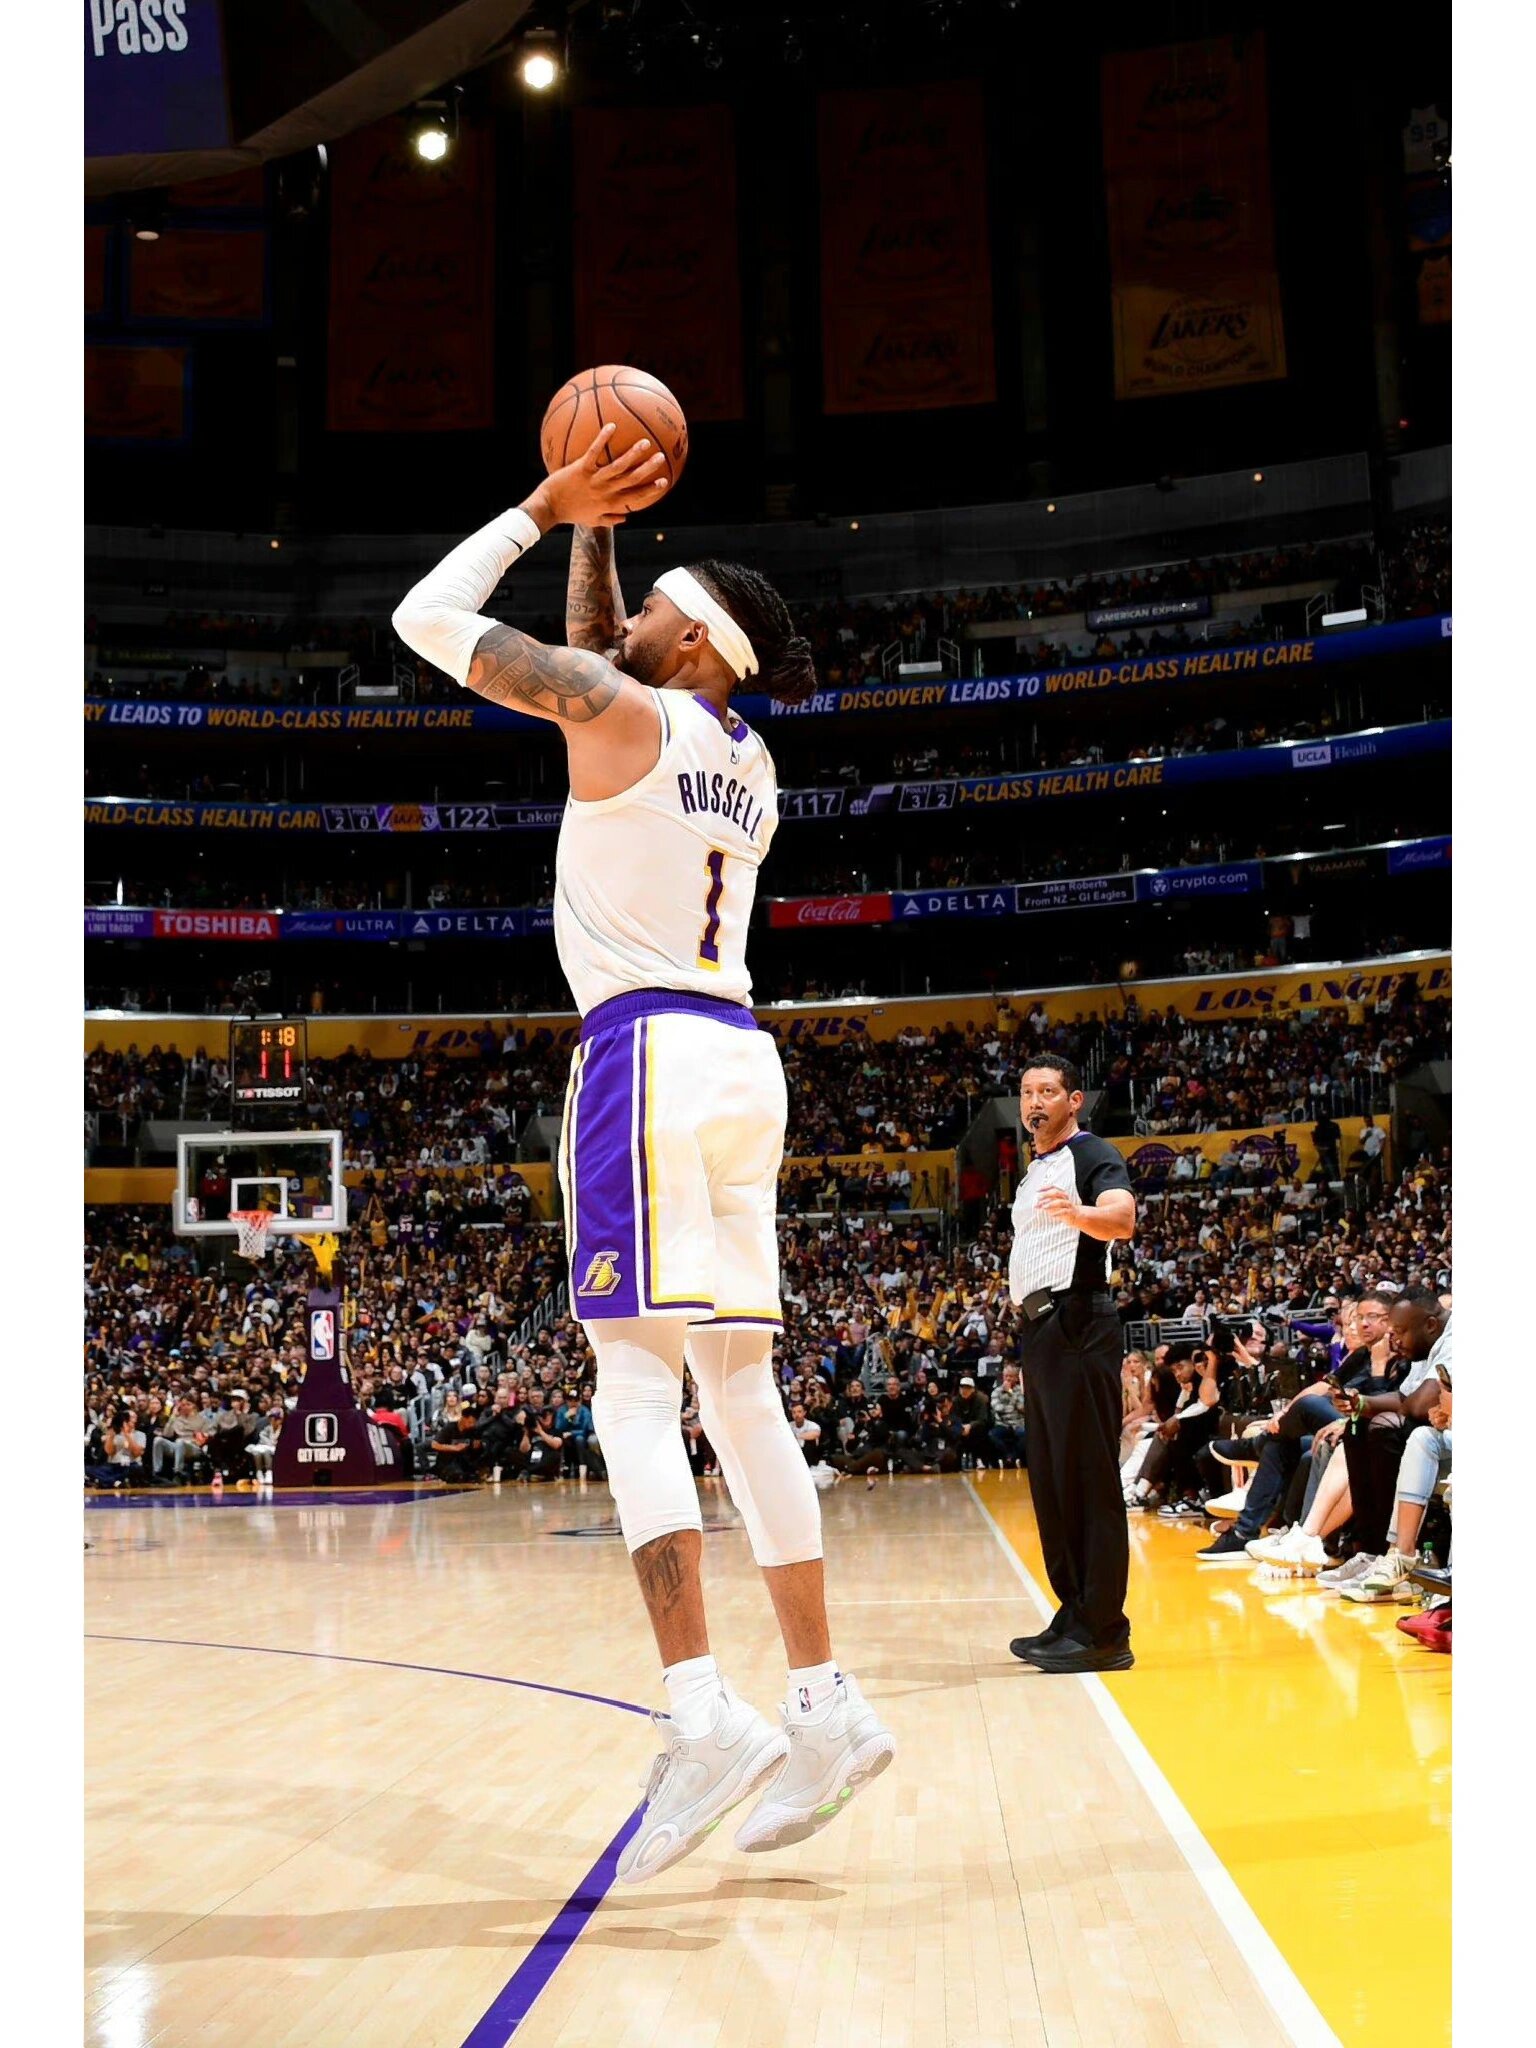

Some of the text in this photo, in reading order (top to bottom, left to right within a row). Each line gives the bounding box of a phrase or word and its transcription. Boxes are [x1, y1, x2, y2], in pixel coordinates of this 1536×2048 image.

[89, 0, 188, 56] Pass
[1096, 608, 1149, 623] AMERICAN
[839, 686, 947, 711] DISCOVERY
[950, 680, 1011, 703] LEADS
[1017, 677, 1040, 697] TO
[1044, 660, 1178, 692] WORLD-CLASS
[1183, 649, 1258, 676] HEALTH
[1262, 642, 1315, 666] CARE
[109, 704, 172, 724] LEADS
[178, 706, 202, 725] TO
[207, 708, 342, 728] WORLD-CLASS
[346, 709, 419, 728] HEALTH
[424, 709, 474, 728] CARE
[1298, 741, 1377, 762] UCLA Health
[1037, 773, 1109, 797] HEALTH
[1114, 764, 1163, 788] CARE
[677, 770, 763, 841] RUSSELL
[793, 793, 836, 816] 117
[912, 794, 947, 808] 3 2
[200, 808, 274, 828] HEALTH
[335, 816, 369, 830] 2 0
[446, 808, 489, 829] 122
[1042, 880, 1108, 894] Jake Roberts
[1172, 872, 1248, 890] crypto.com
[929, 894, 1005, 912] DELTA
[1025, 896, 1051, 908] From
[1054, 894, 1068, 904] NZ
[1093, 889, 1127, 902] Eagles
[697, 849, 725, 971] 1
[160, 914, 273, 935] TOSHIBA
[346, 919, 396, 932] ULTRA
[437, 916, 515, 932] DELTA
[1195, 986, 1277, 1011] LOS
[254, 1087, 301, 1098] TISSOT
